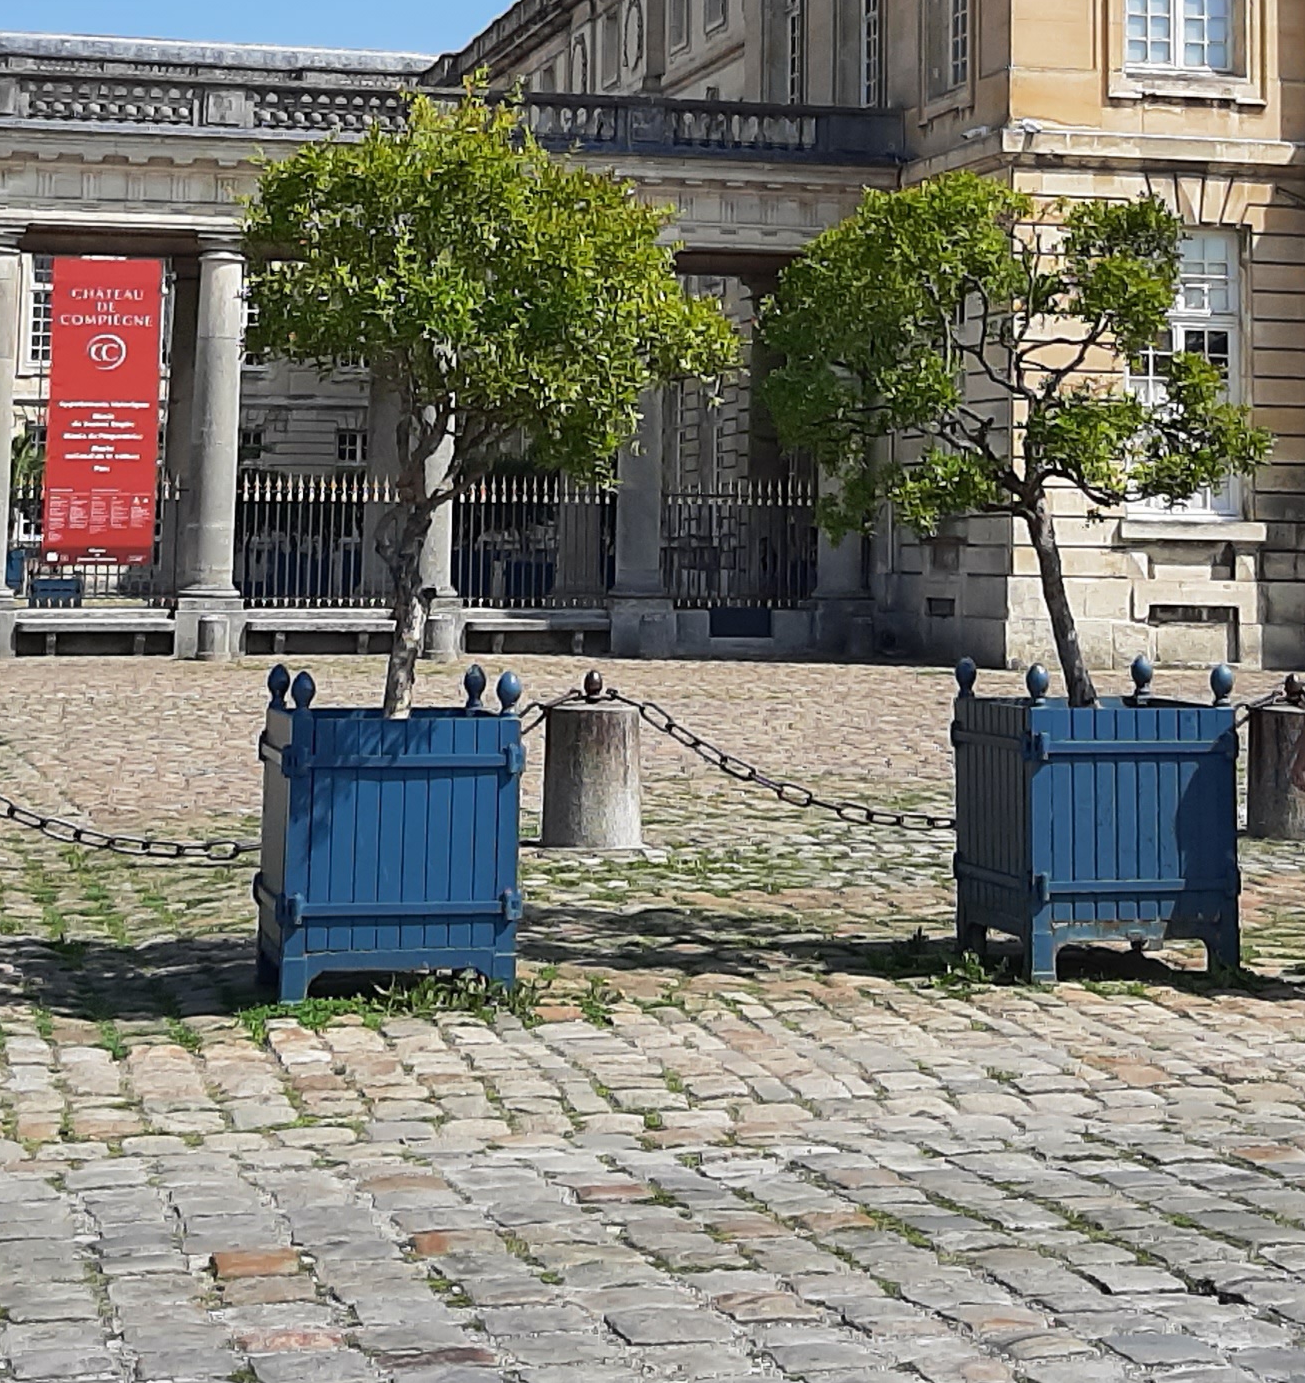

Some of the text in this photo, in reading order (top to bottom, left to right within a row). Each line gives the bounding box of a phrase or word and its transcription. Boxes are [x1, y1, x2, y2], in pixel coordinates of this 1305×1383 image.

[70, 286, 145, 301] CHÂTEAU
[96, 301, 116, 313] DE
[59, 313, 154, 328] COMPIÈGNE
